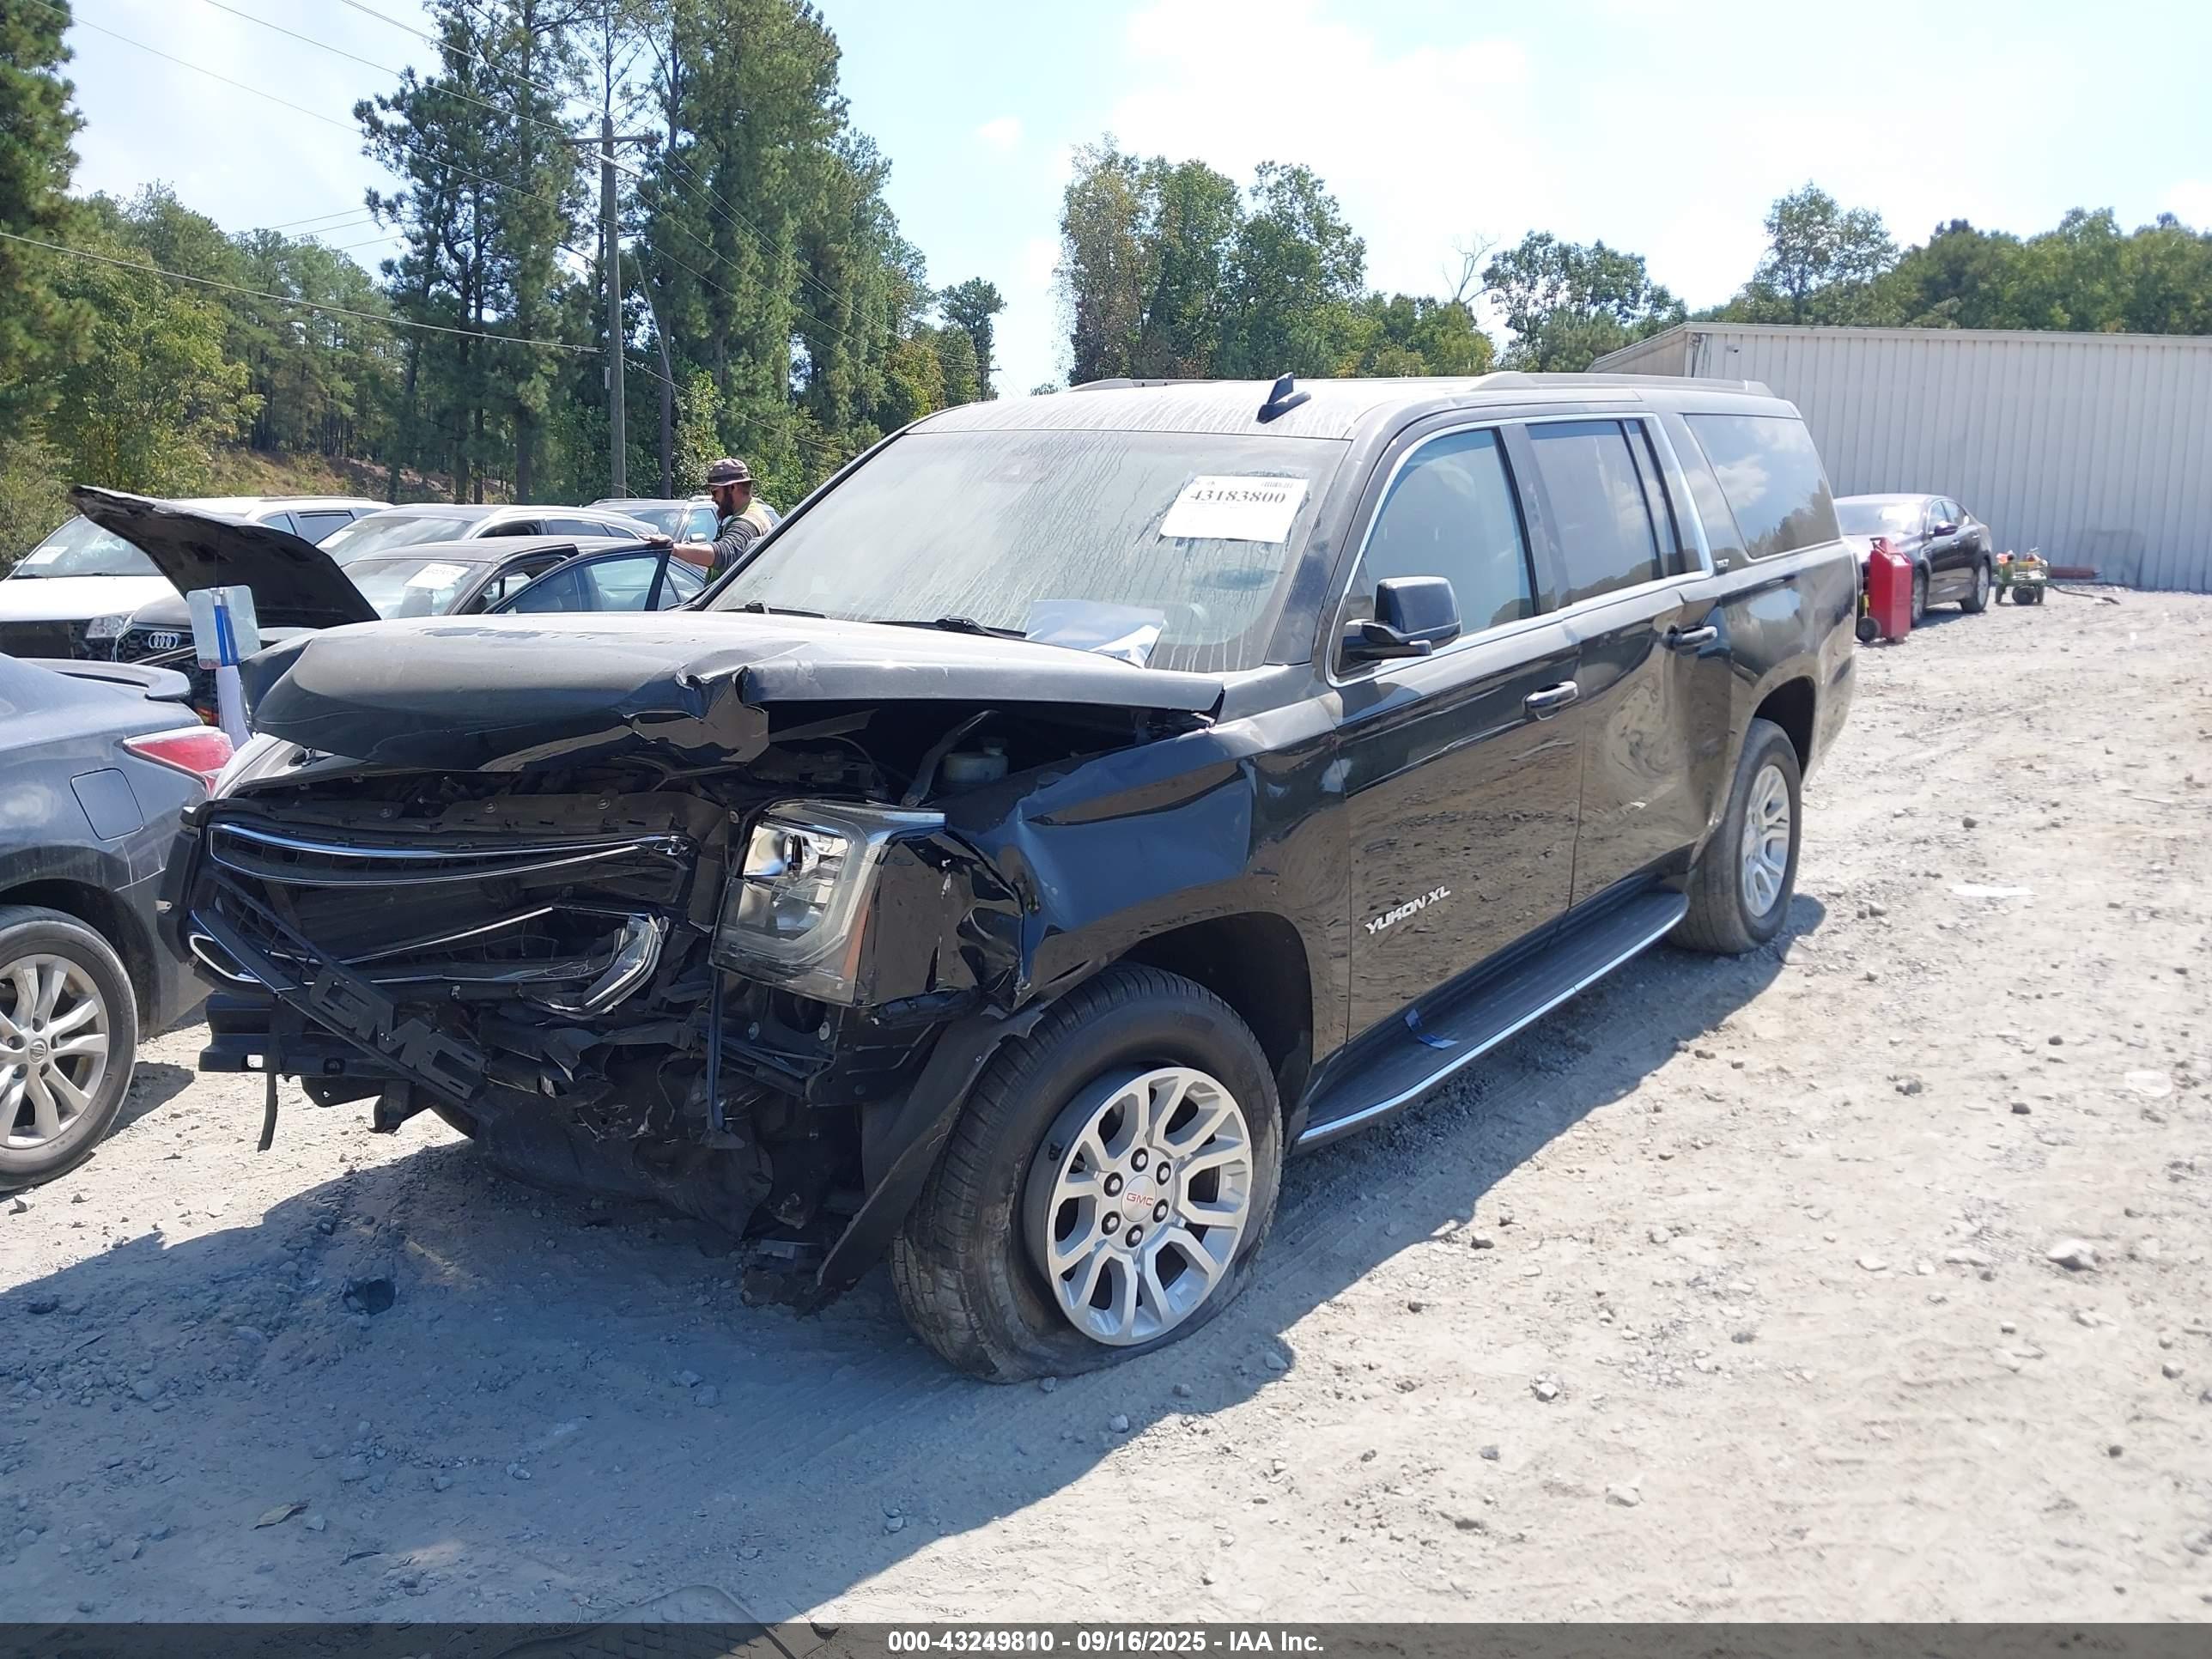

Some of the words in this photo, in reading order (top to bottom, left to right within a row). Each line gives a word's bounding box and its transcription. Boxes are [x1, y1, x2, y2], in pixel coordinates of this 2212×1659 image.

[1190, 489, 1286, 503] 43183800
[1364, 895, 1425, 934] YUKON
[1427, 886, 1451, 906] XL
[1127, 1193, 1154, 1206] GMC
